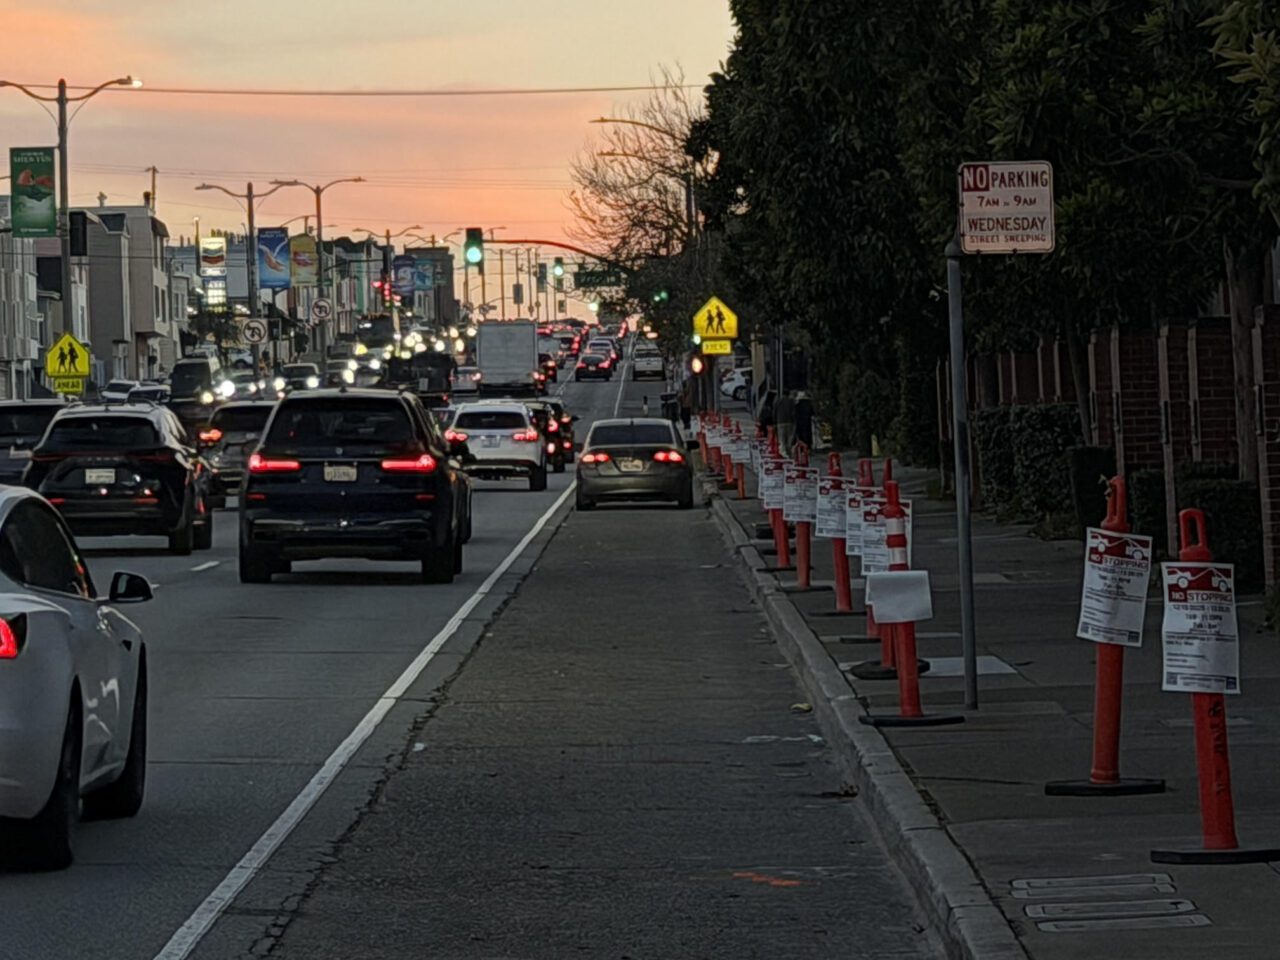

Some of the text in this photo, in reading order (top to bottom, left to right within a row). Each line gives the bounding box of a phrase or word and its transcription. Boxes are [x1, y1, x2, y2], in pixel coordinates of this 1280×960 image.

[963, 166, 1049, 190] NO PARKING
[977, 195, 1000, 207] 7AM
[1013, 195, 1037, 206] 9AM
[968, 216, 1047, 232] WEDNESDAY
[969, 234, 1047, 244] STREET SWEEPING
[57, 380, 80, 389] AHEAD
[1104, 556, 1149, 570] STOPPING
[1187, 592, 1233, 602] STOPPING
